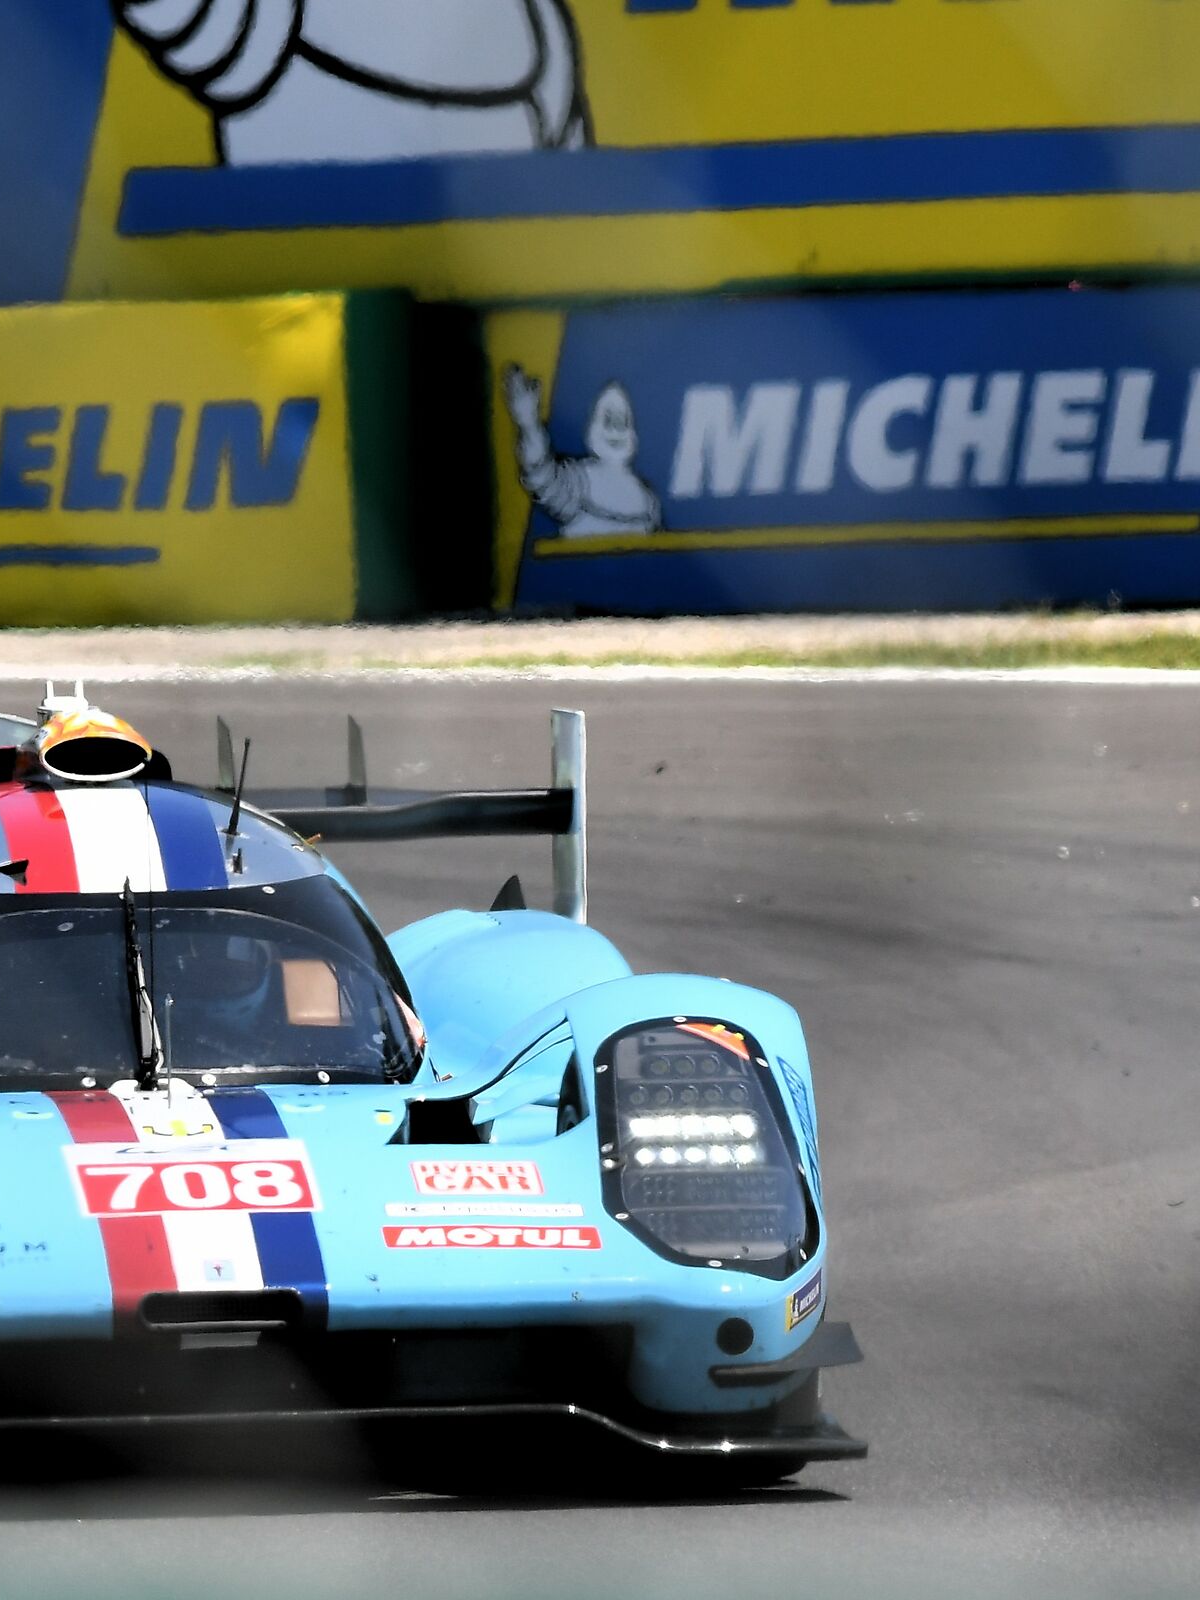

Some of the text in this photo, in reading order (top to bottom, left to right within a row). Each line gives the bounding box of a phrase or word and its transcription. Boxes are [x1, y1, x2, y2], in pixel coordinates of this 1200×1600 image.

[86, 1162, 302, 1210] 708
[424, 1175, 532, 1191] CAR
[396, 1227, 591, 1246] MOTUL
